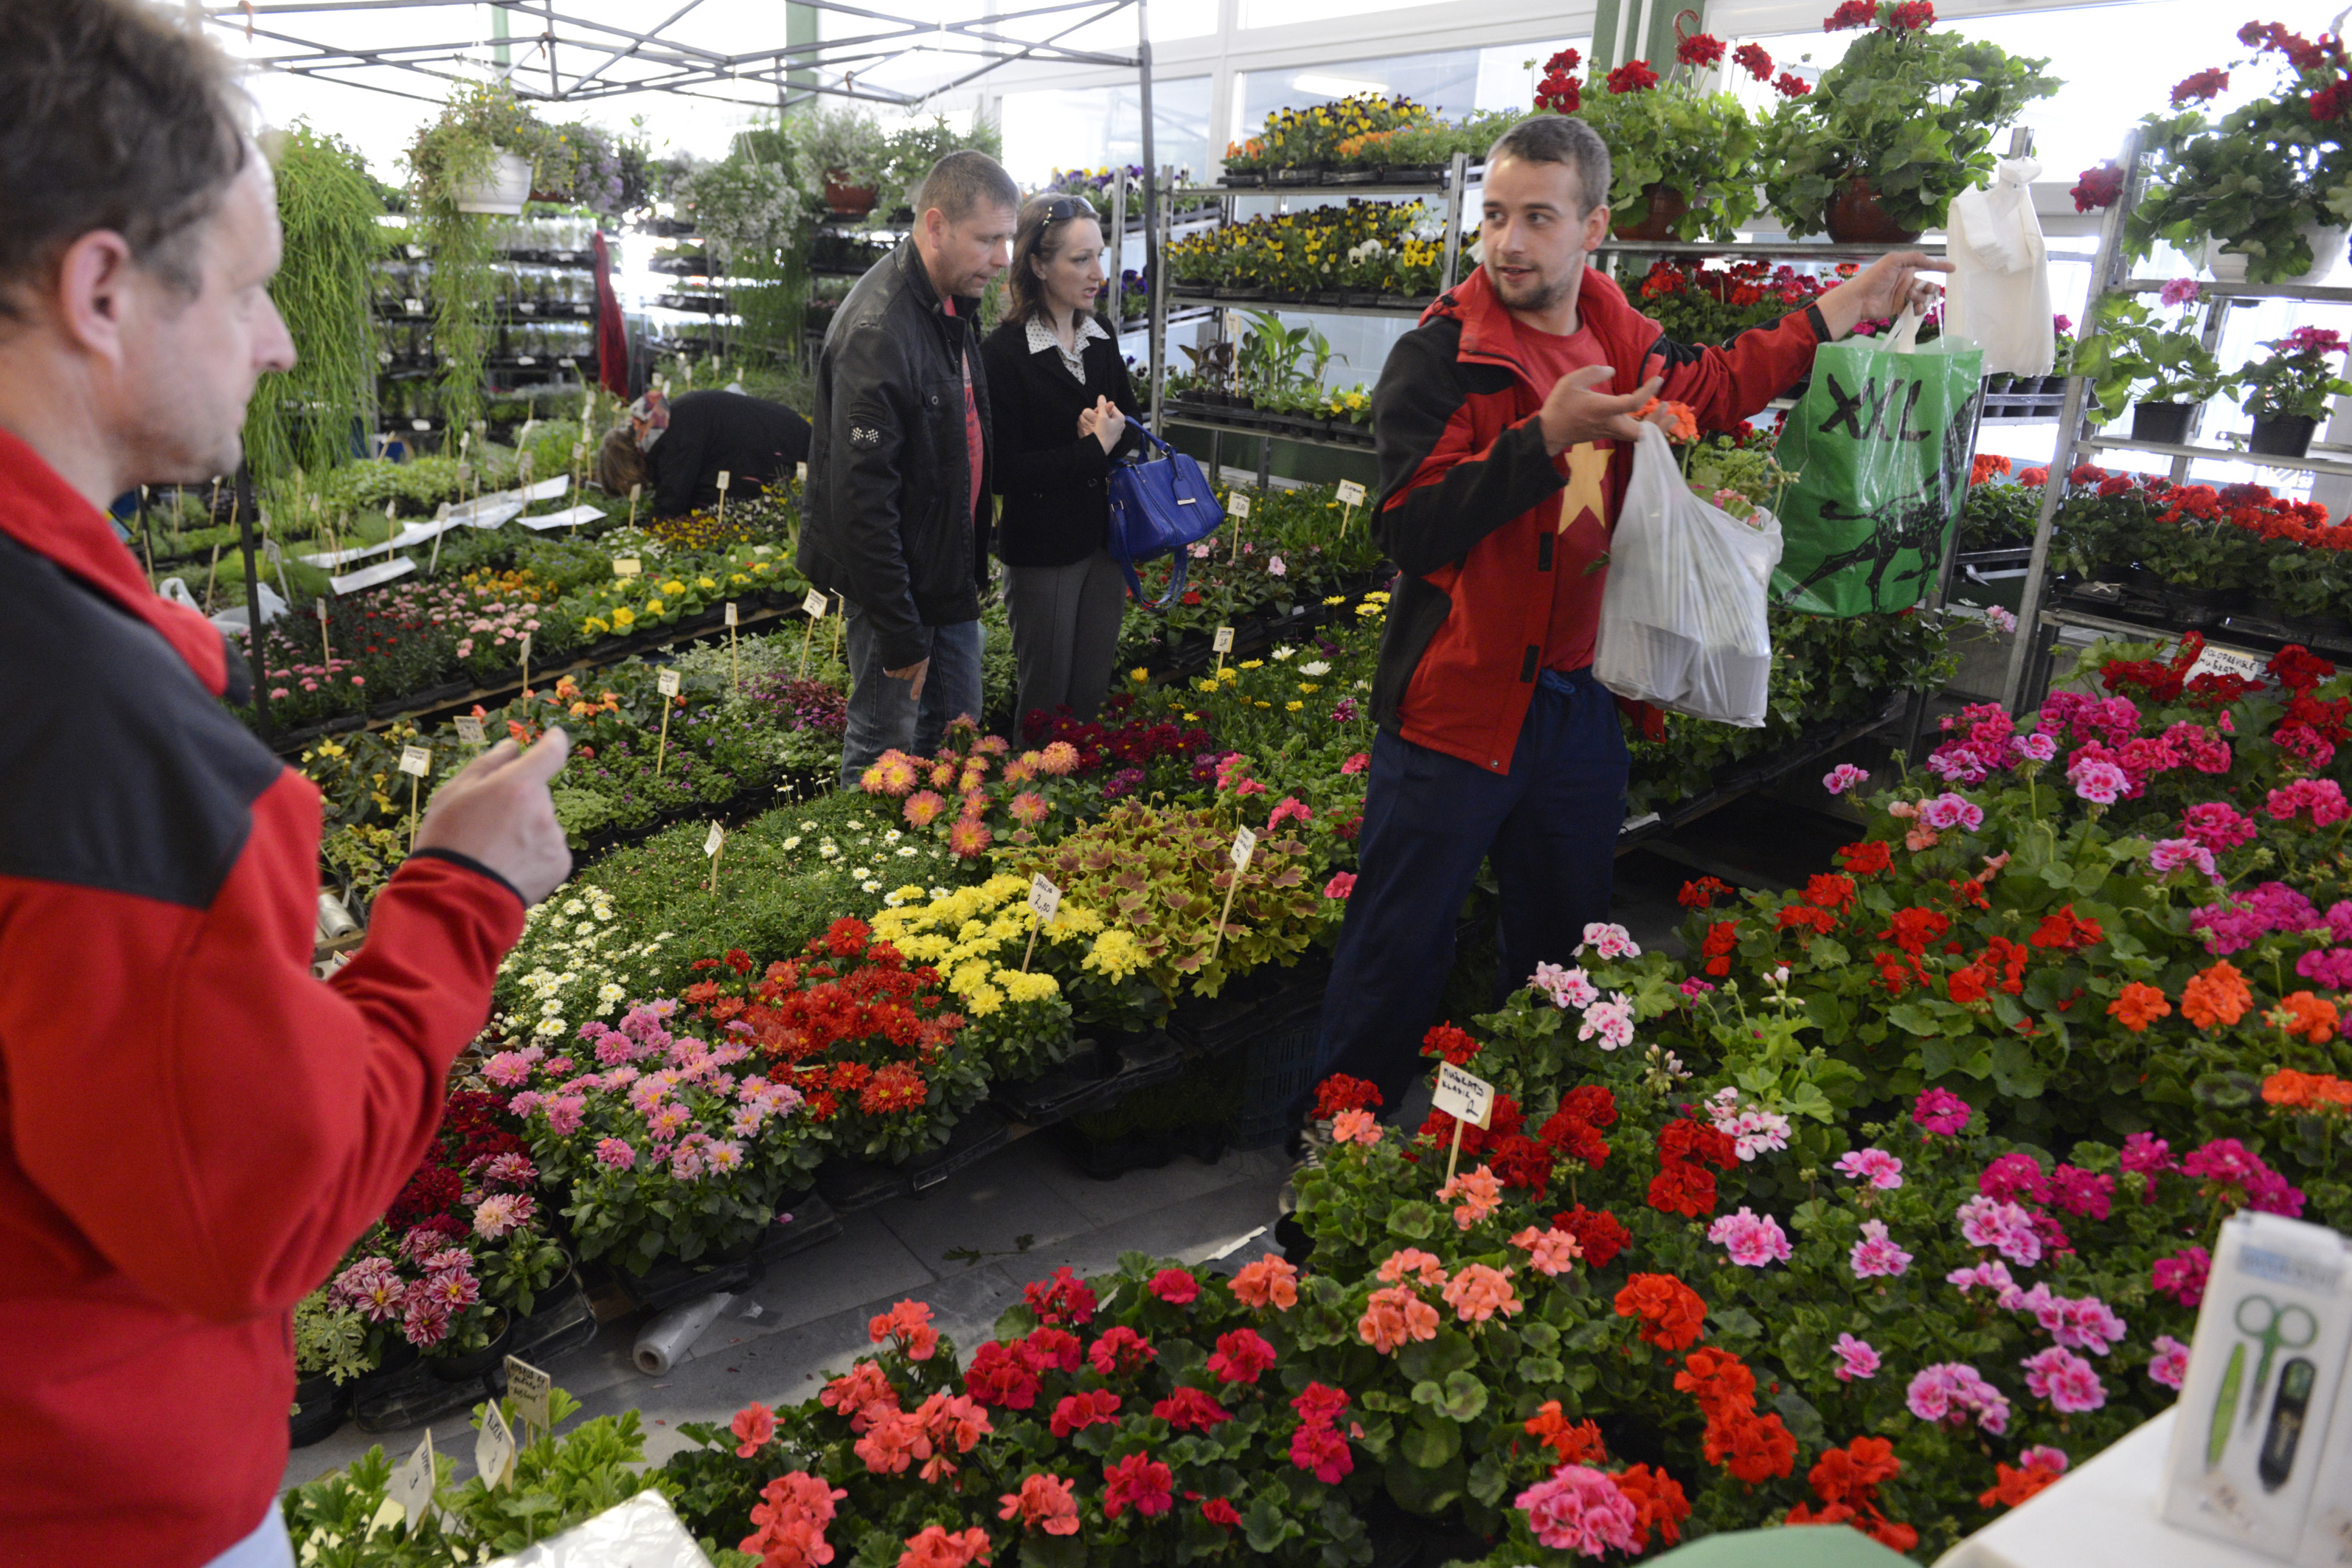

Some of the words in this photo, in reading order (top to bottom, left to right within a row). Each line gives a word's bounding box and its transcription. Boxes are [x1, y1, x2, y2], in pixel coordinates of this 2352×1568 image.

[1818, 373, 1931, 443] XXL
[1035, 878, 1052, 895] DAHLIA
[1034, 894, 1051, 913] 2,50
